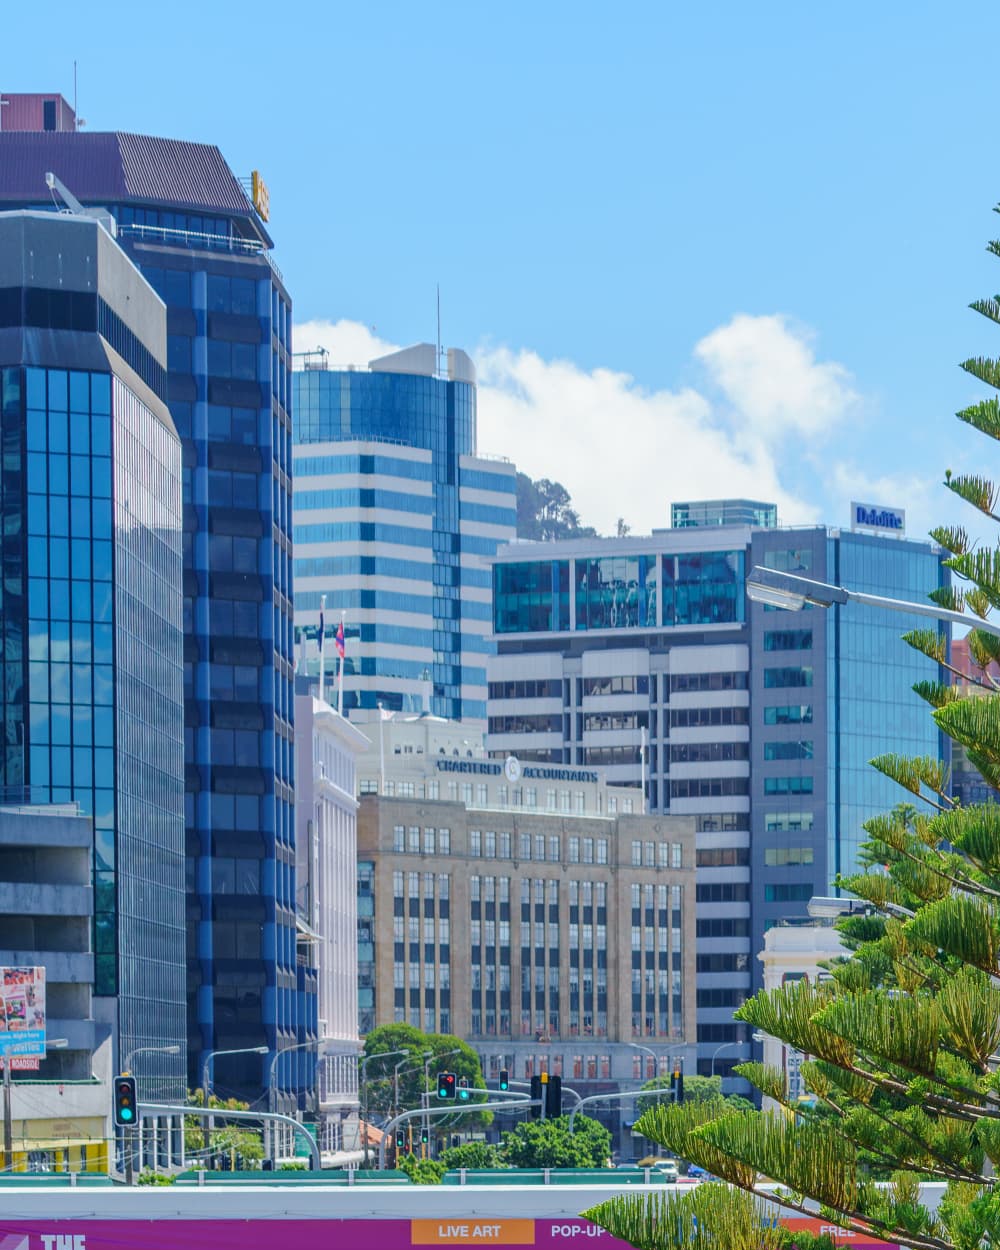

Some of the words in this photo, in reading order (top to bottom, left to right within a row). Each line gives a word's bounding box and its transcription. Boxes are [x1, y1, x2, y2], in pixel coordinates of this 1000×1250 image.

[437, 760, 502, 776] CHARTERED
[523, 766, 598, 783] ACCOUNTANTS
[438, 1225, 469, 1237] LIVE
[472, 1225, 502, 1237] ART
[551, 1225, 606, 1237] POP-UP
[820, 1225, 856, 1237] FREE
